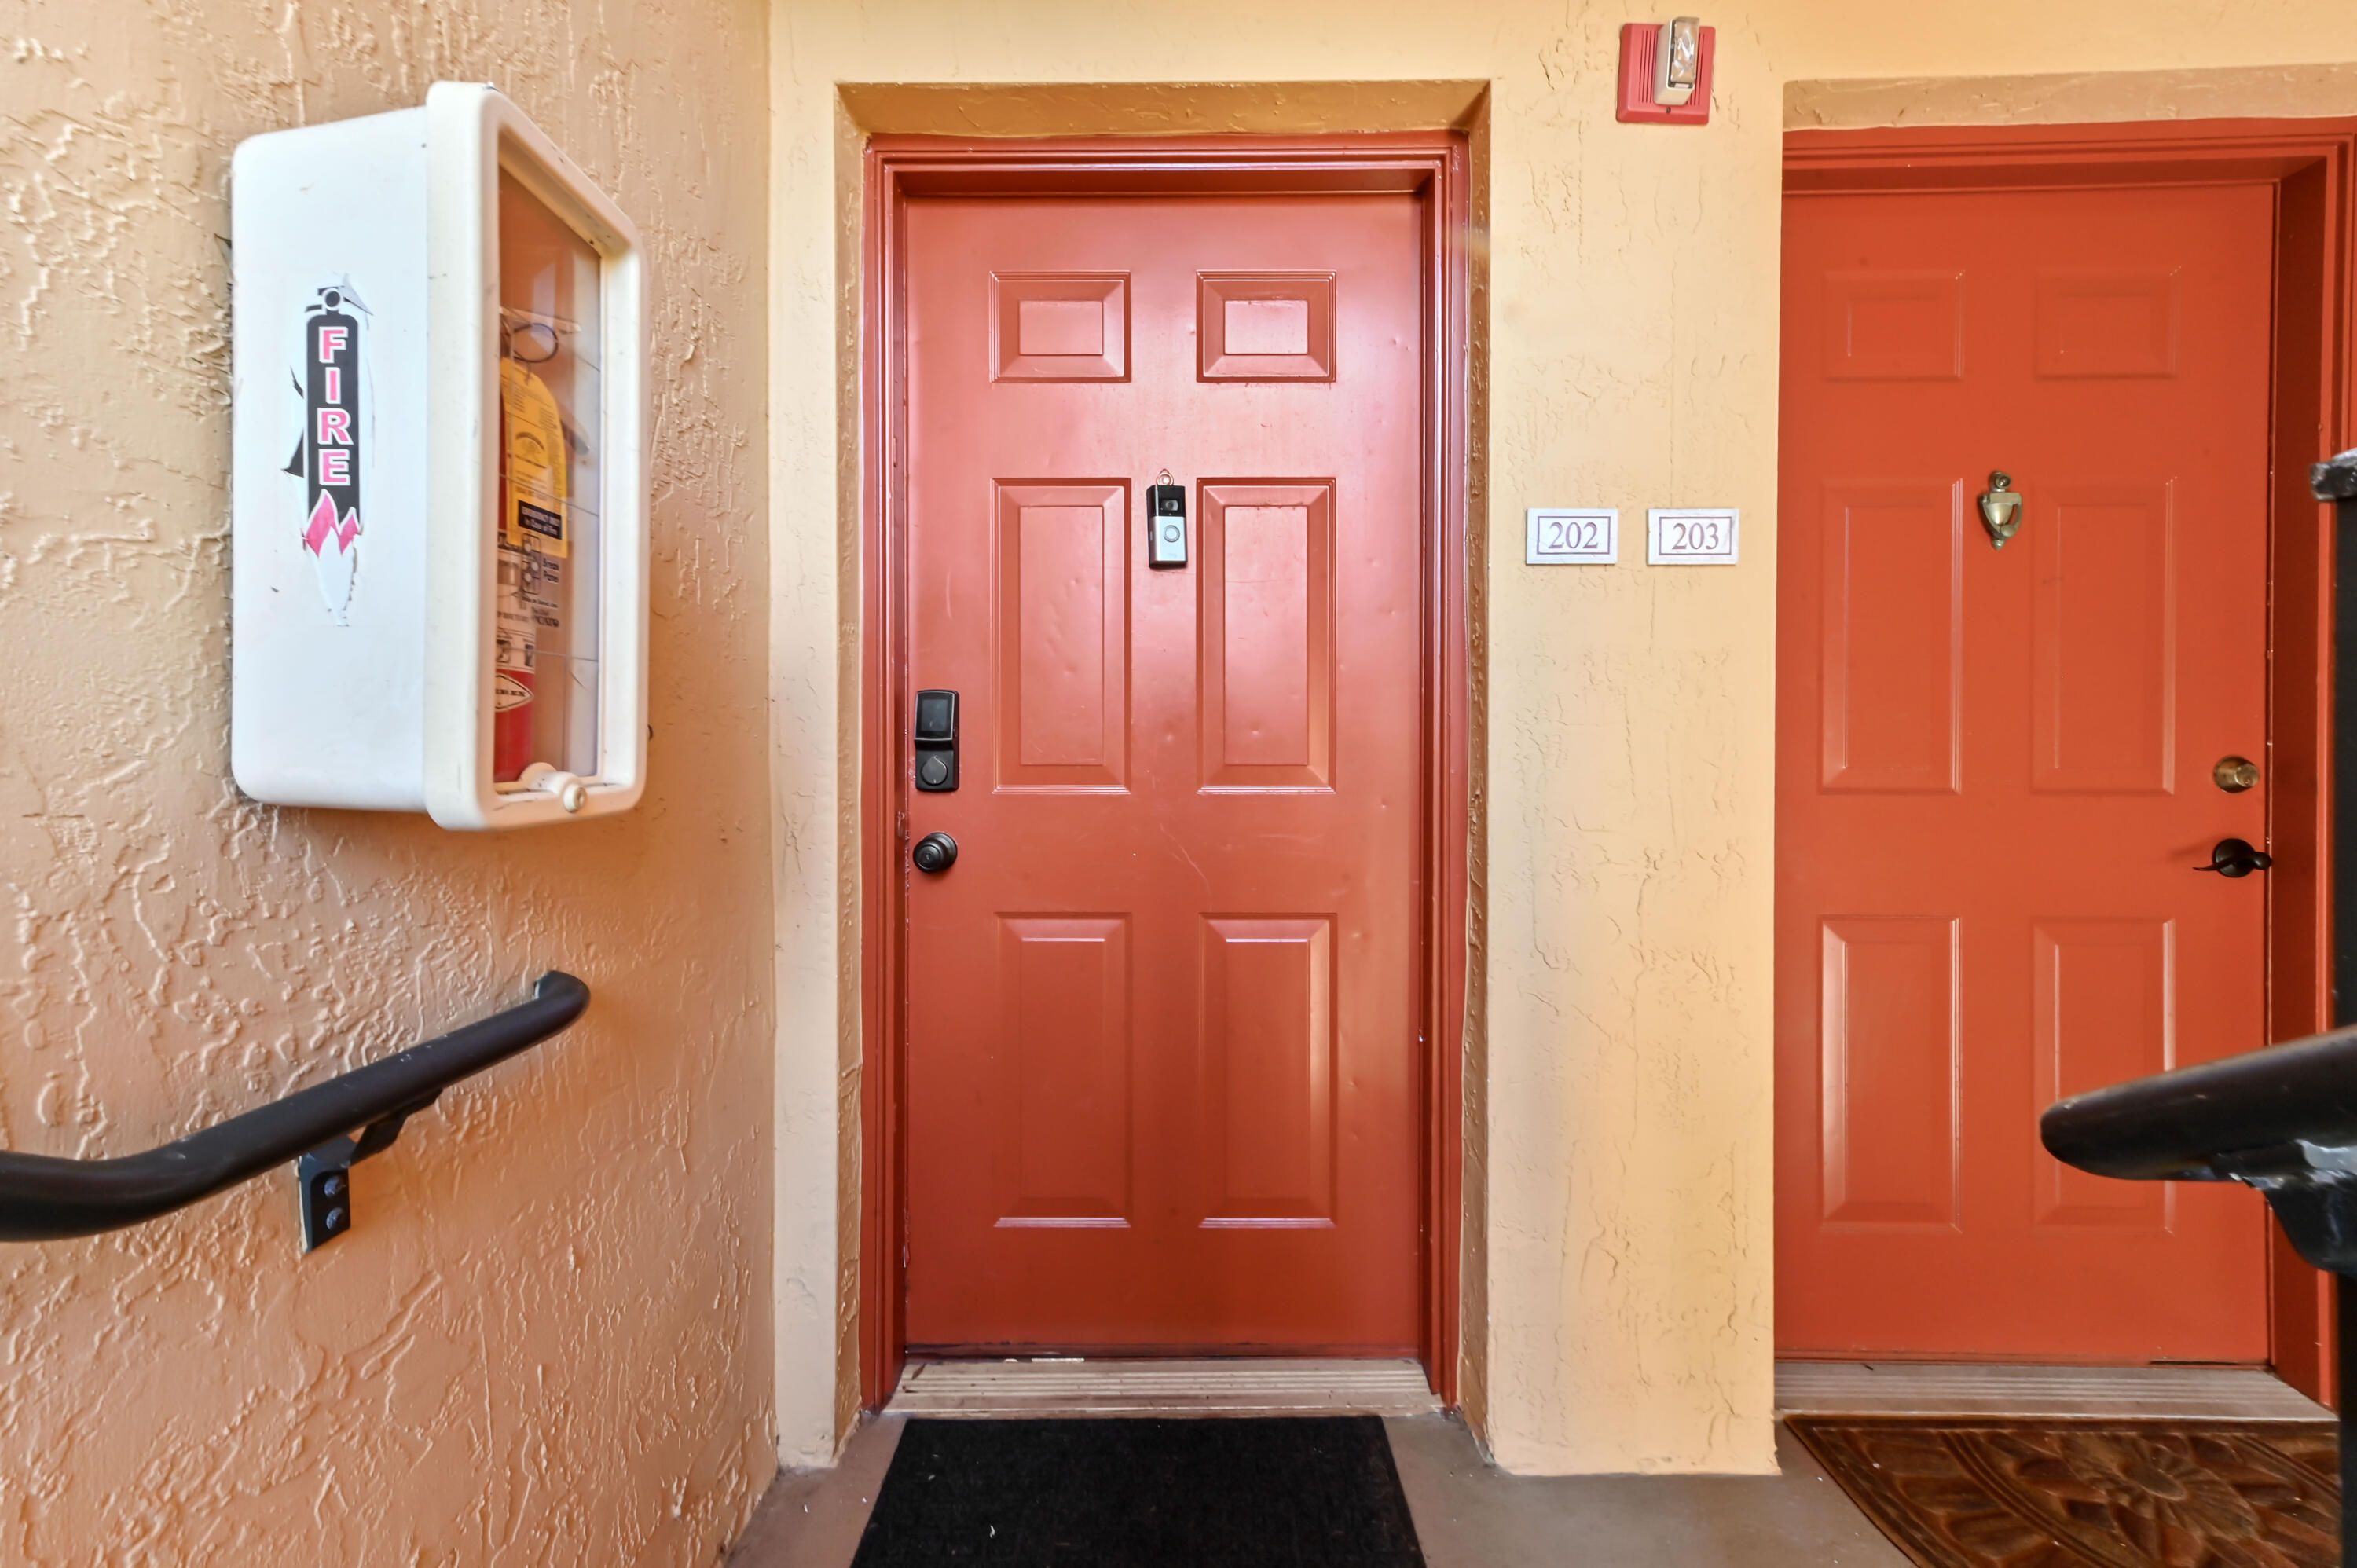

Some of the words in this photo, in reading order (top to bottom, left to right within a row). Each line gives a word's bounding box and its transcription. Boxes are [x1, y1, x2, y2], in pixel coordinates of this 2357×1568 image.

[317, 326, 354, 486] FIRE
[1548, 522, 1599, 549] 202
[1671, 522, 1720, 550] 203
